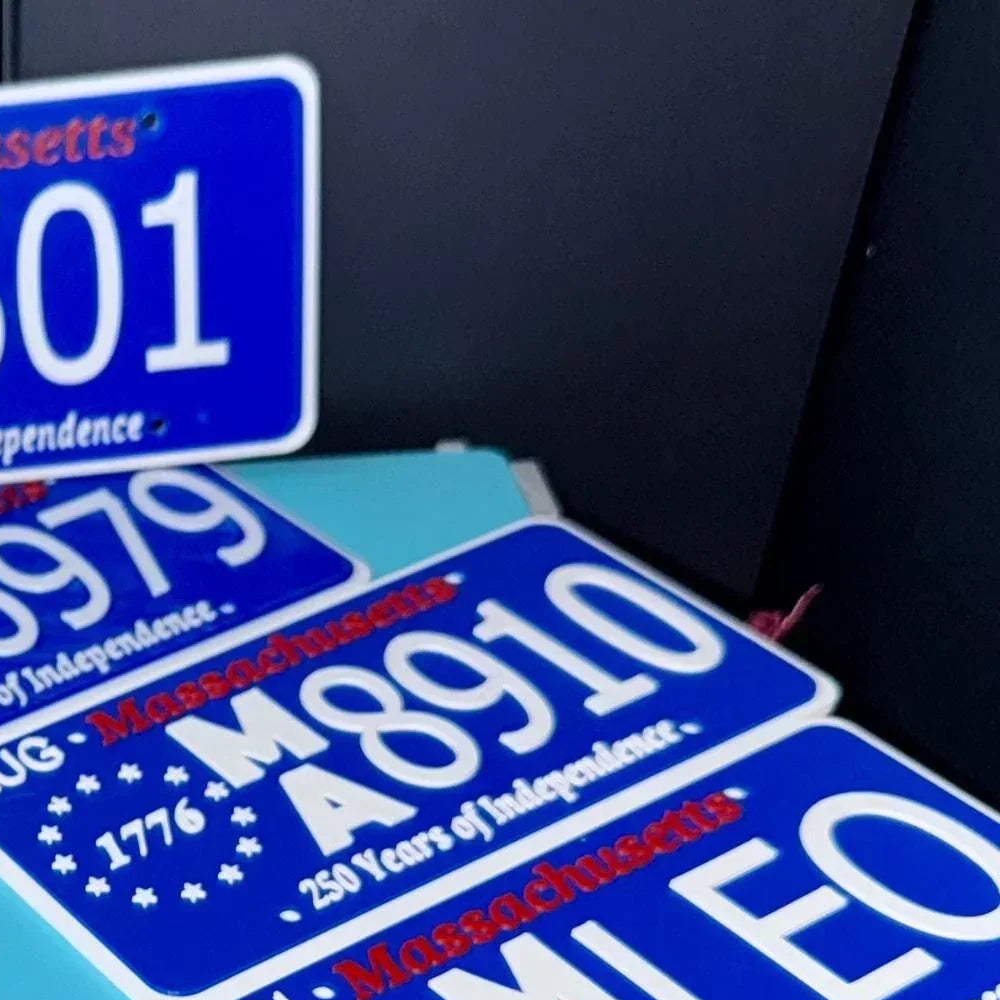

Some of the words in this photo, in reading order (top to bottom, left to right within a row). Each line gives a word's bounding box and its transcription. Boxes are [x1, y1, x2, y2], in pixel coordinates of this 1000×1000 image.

[20, 599, 218, 694] Independence
[85, 574, 459, 748] Massachusetts
[300, 562, 724, 791] 8910
[95, 796, 208, 872] 1776
[299, 862, 363, 911] 250
[351, 824, 455, 882] Years
[451, 799, 494, 842] of
[478, 719, 682, 825] Independence
